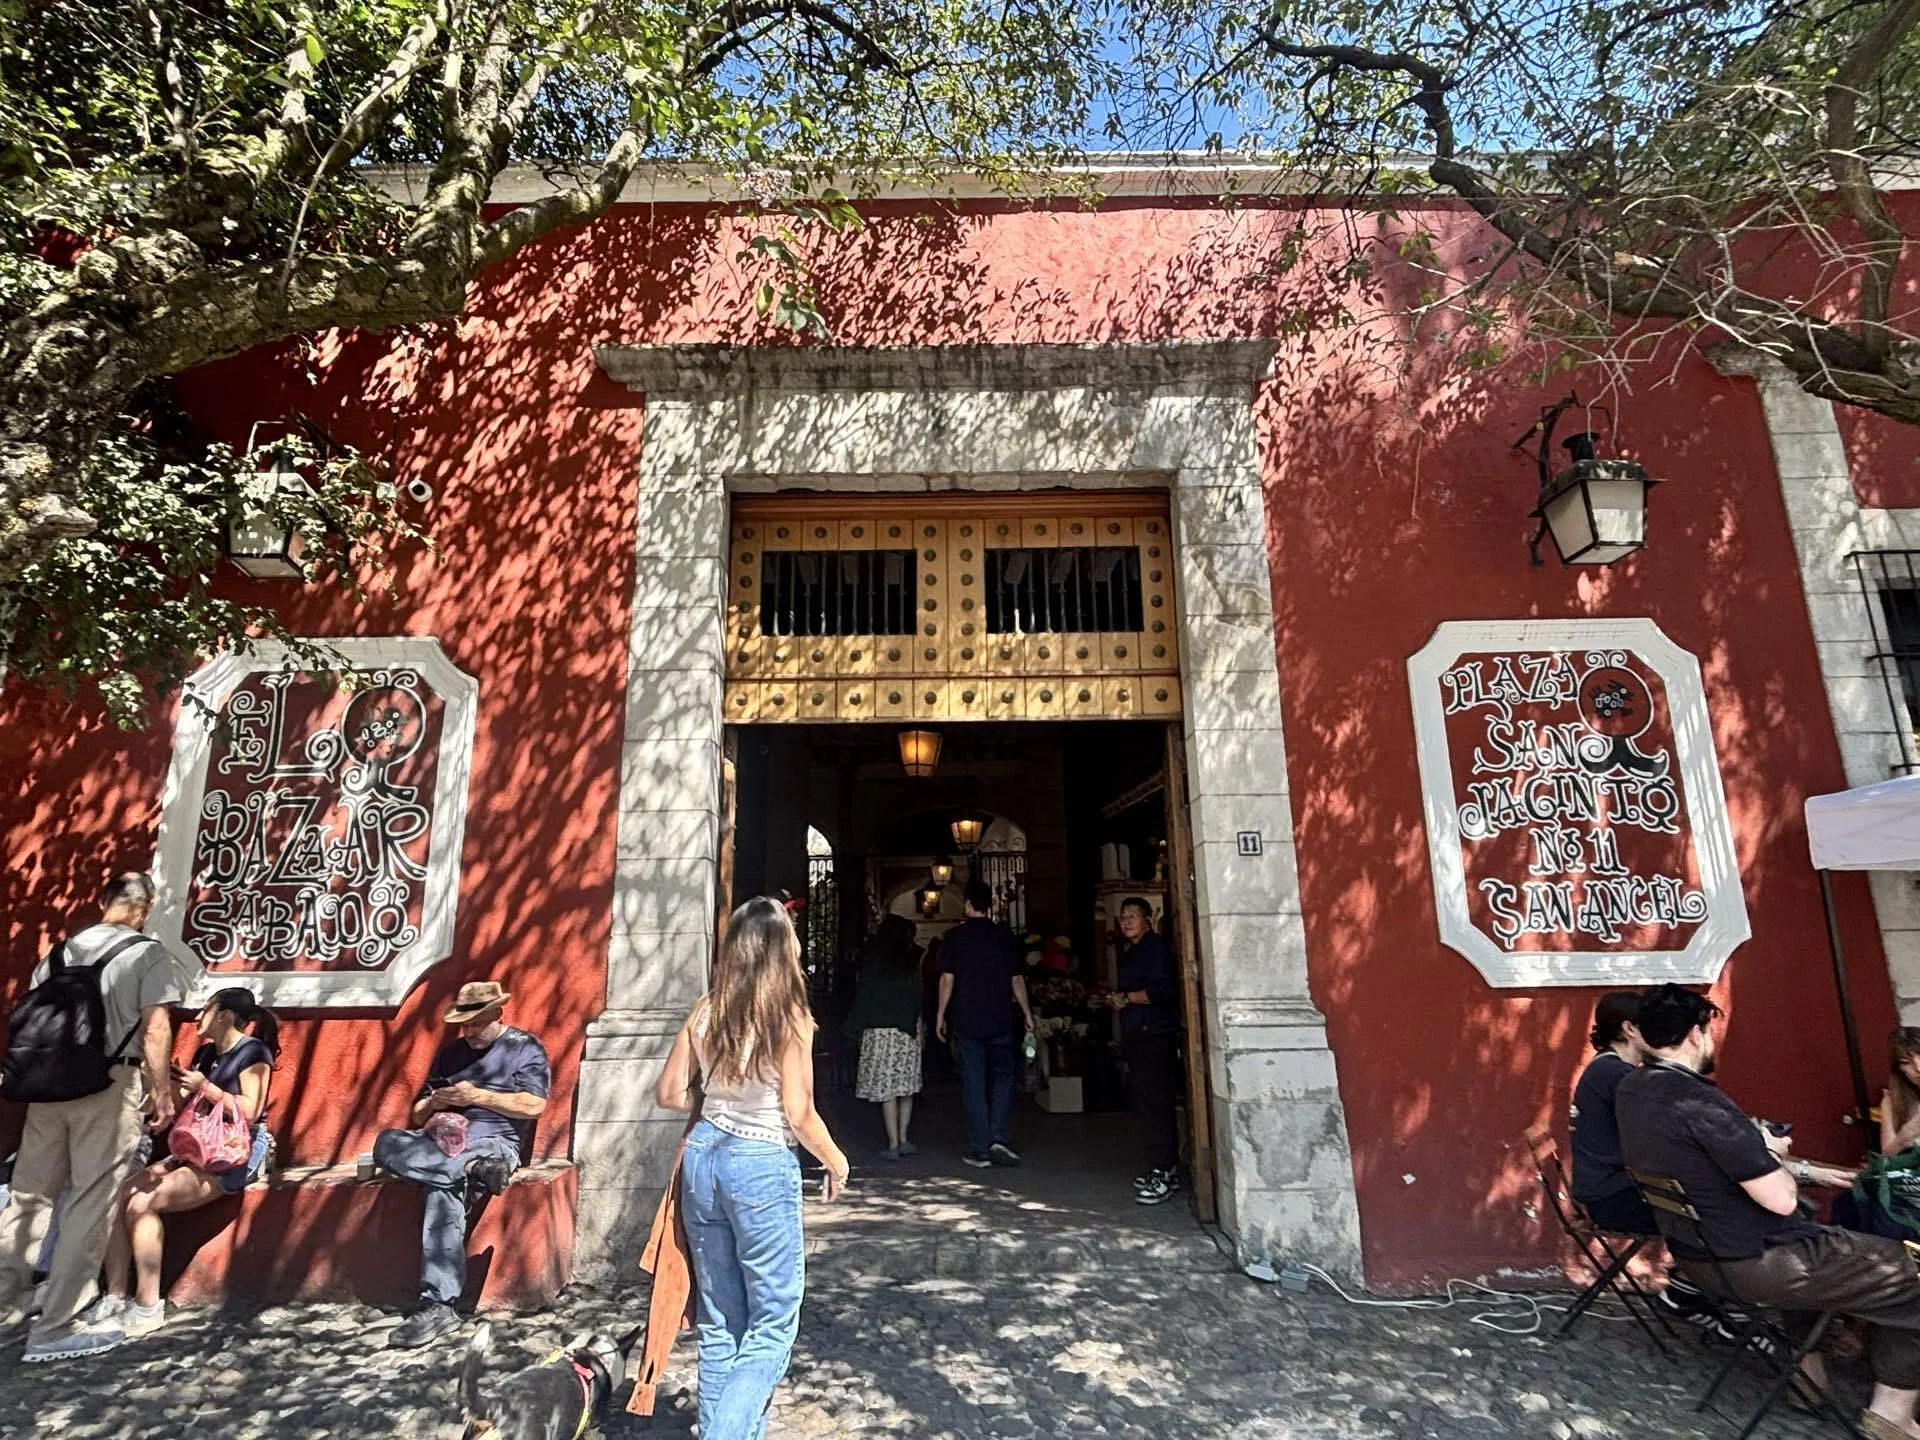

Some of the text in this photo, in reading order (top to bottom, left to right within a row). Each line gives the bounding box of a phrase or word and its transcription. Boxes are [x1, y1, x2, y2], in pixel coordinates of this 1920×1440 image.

[1444, 653, 1580, 719] PLAZA
[218, 672, 344, 783] EL
[1473, 715, 1585, 776] SAN
[199, 788, 430, 890] BAZAAR
[1458, 772, 1679, 840] JACINTO
[1241, 835, 1259, 853] 11
[1587, 828, 1629, 875] 11
[188, 884, 417, 966] SABADO
[1479, 873, 1708, 949] SAN ANGEL
